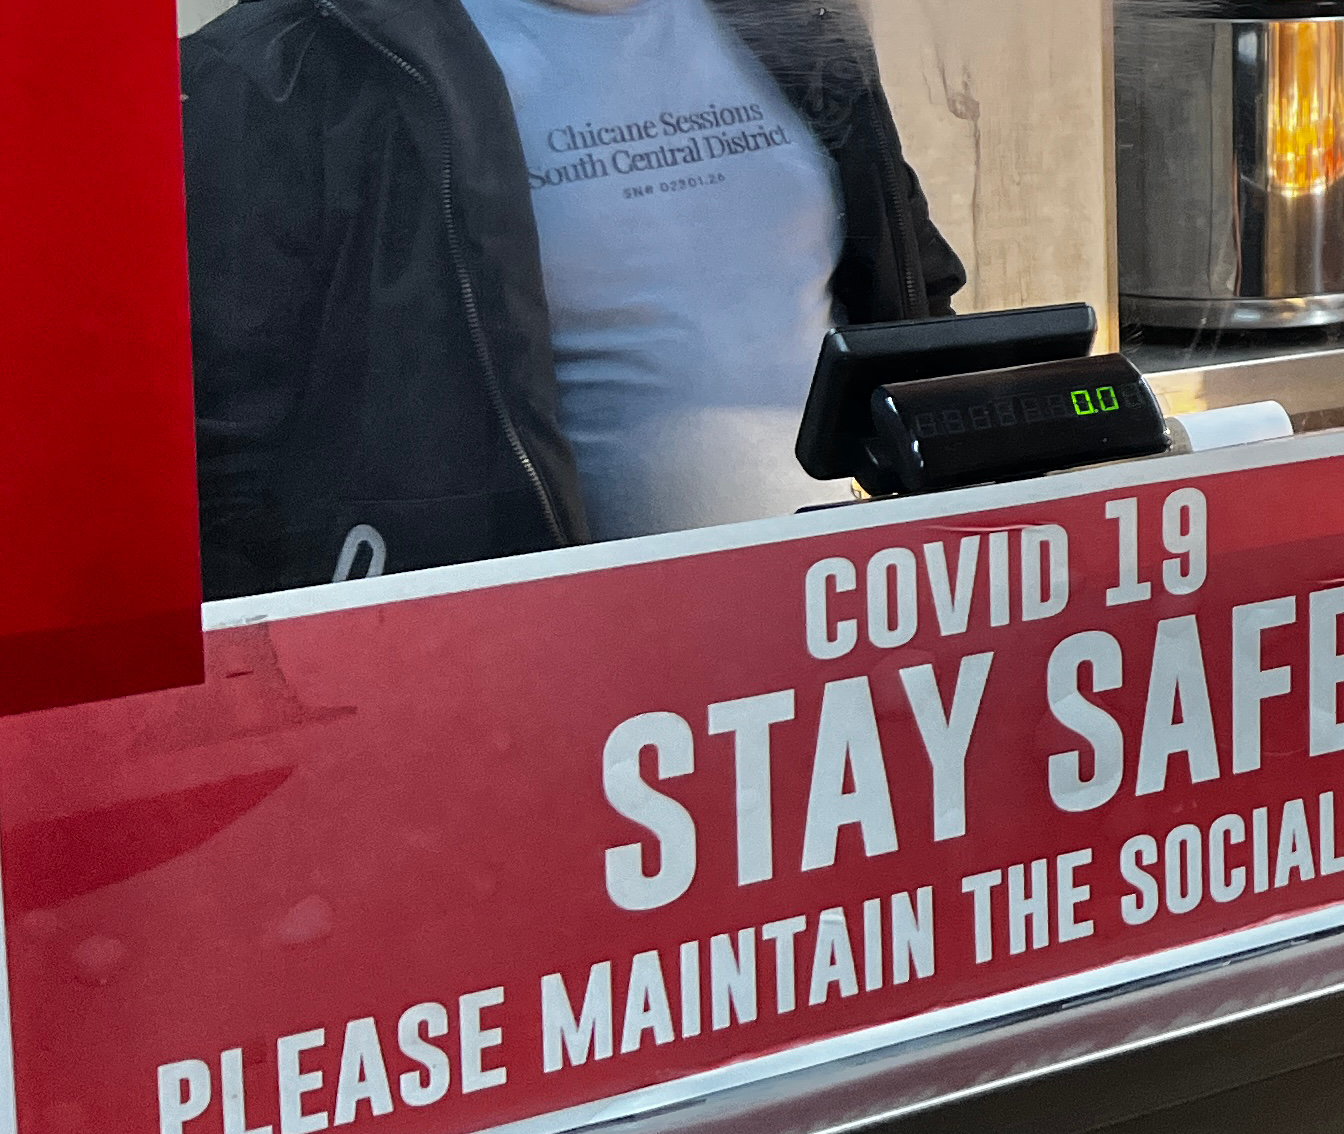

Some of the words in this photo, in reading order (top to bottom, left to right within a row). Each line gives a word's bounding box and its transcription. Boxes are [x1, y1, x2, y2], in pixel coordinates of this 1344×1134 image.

[528, 153, 609, 189] South
[611, 137, 703, 175] Central
[702, 124, 791, 159] District
[548, 122, 658, 153] Chicane
[659, 104, 764, 137] Sessions
[1072, 384, 1120, 418] 0.0
[805, 523, 1070, 660] COVID
[1104, 487, 1209, 609] 19
[602, 651, 995, 912] STAY
[157, 986, 507, 1134] PLEASE
[541, 884, 935, 1075] MAINTAIN
[962, 847, 1095, 964] THE
